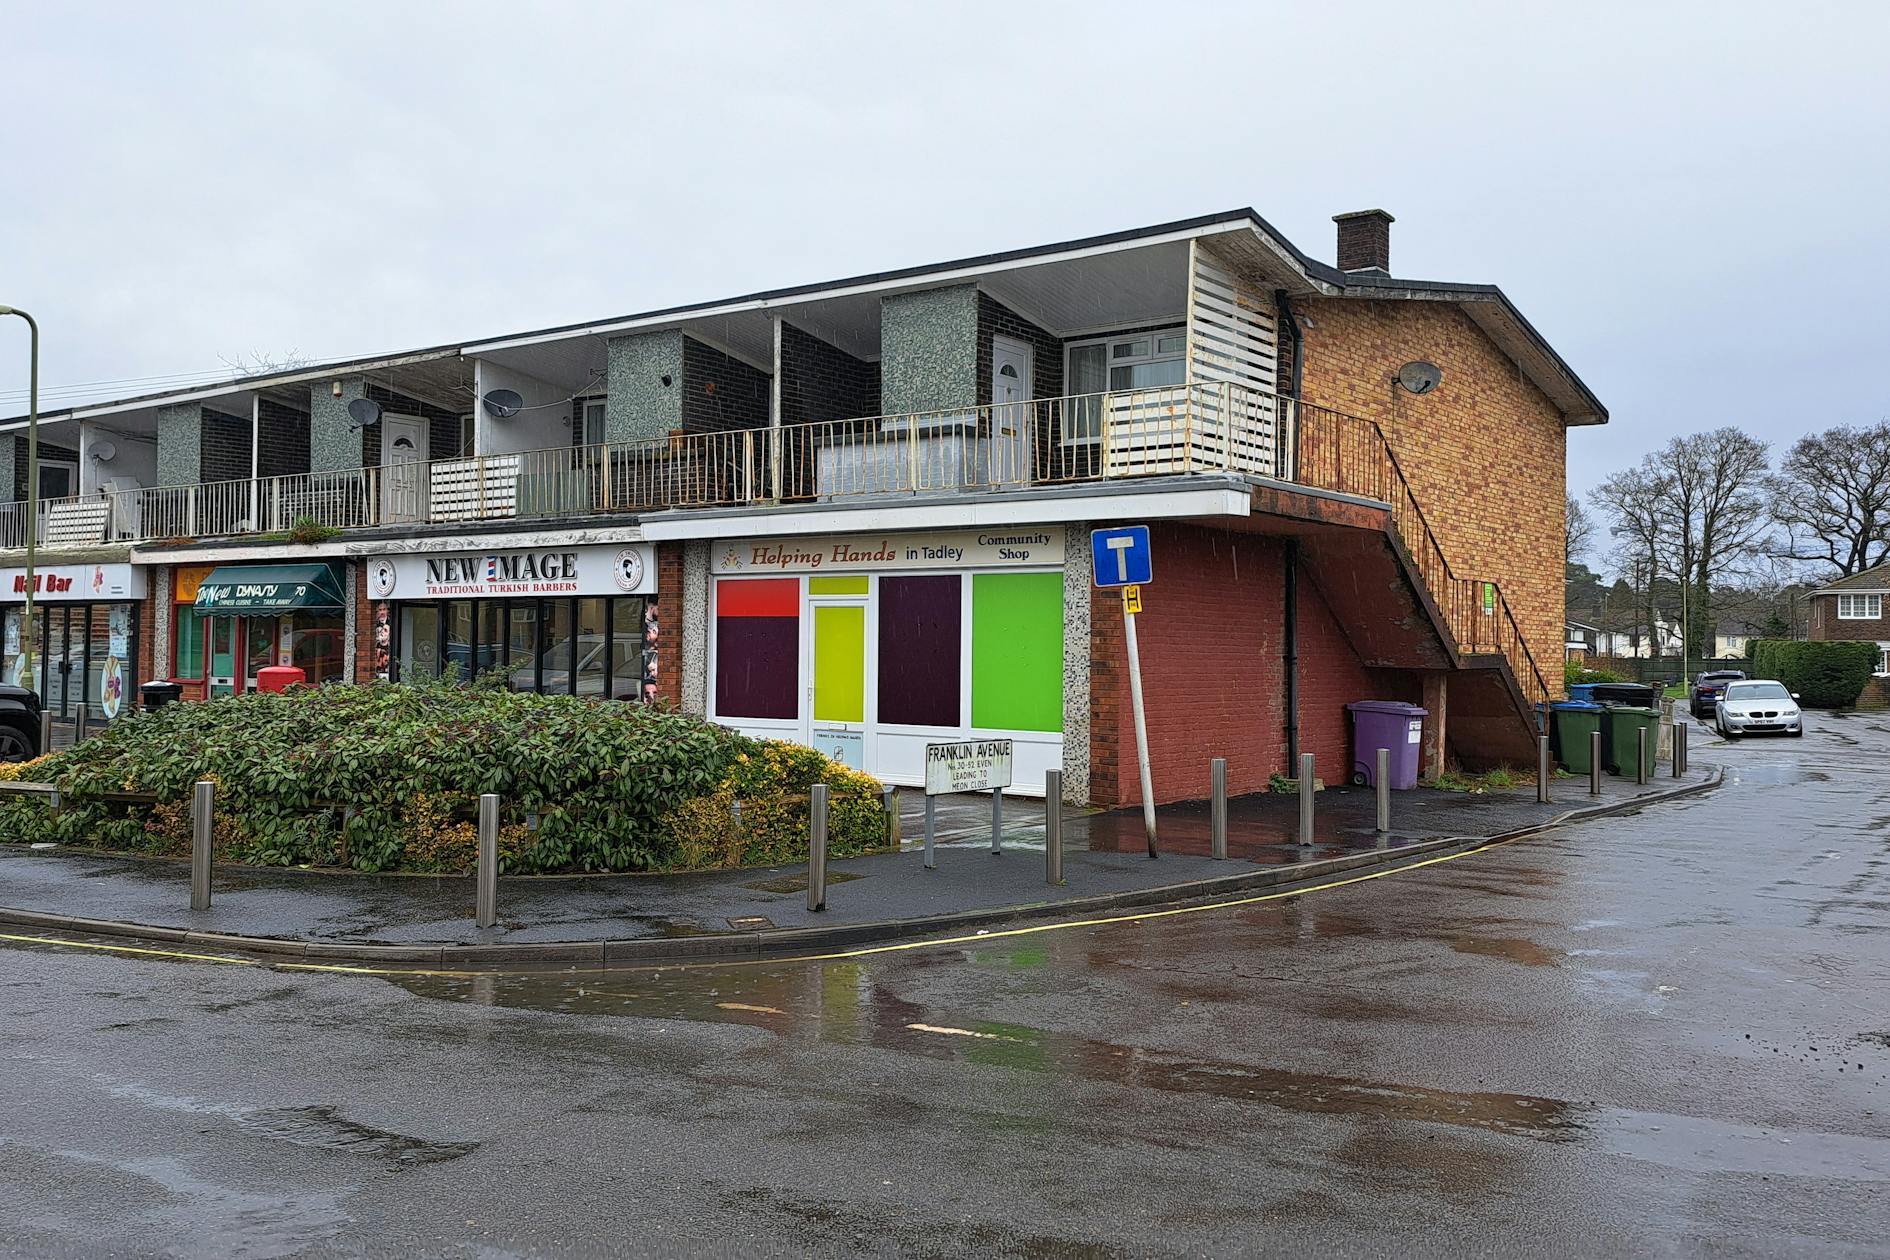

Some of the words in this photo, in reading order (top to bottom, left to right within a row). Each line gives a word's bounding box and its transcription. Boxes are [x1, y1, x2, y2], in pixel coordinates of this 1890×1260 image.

[978, 532, 1051, 546] Community
[750, 544, 823, 568] Helping
[830, 540, 896, 562] Hands
[906, 546, 918, 560] in
[921, 545, 963, 562] Tadley
[998, 547, 1030, 561] Shop
[425, 556, 482, 583] NEW
[46, 574, 73, 592] Bar
[426, 585, 485, 594] TRADITIONAL
[487, 584, 529, 593] TURKISH
[533, 583, 577, 592] BARBERS
[206, 585, 231, 603] New
[295, 586, 306, 597] 70
[928, 745, 972, 762] FRANKLIN
[977, 742, 1010, 758] AVENUE
[977, 759, 992, 768] EVEN
[953, 771, 977, 781] LEADING
[980, 770, 988, 778] TO
[970, 780, 988, 789] CLOSE
